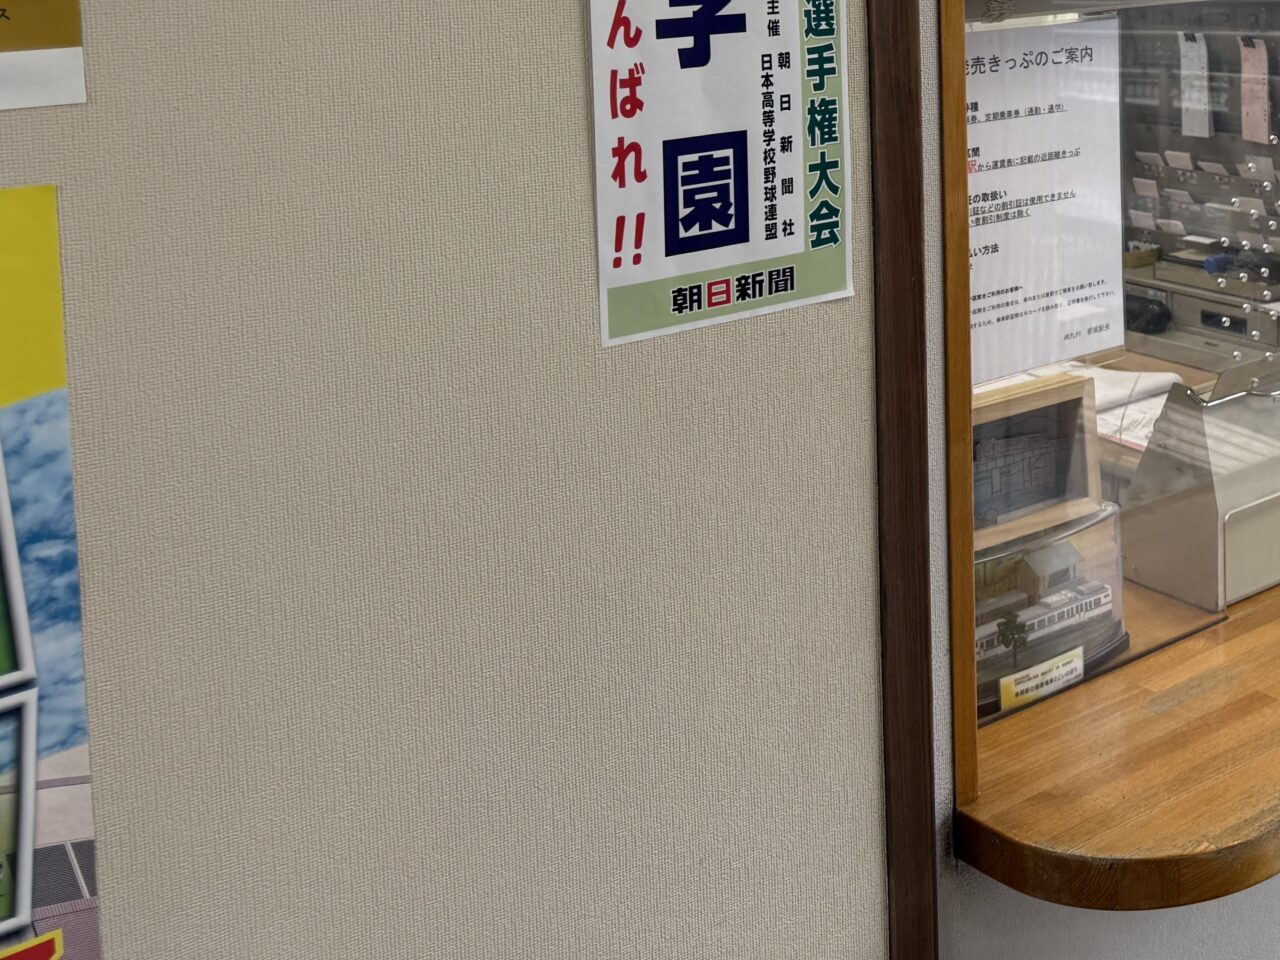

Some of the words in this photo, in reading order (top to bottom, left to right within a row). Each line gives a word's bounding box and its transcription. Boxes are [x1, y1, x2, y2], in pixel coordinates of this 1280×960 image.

[761, 53, 778, 241] 日本高等学校野球連盟
[777, 52, 795, 238] 朝日新聞社
[671, 266, 796, 315] 朝日新聞
